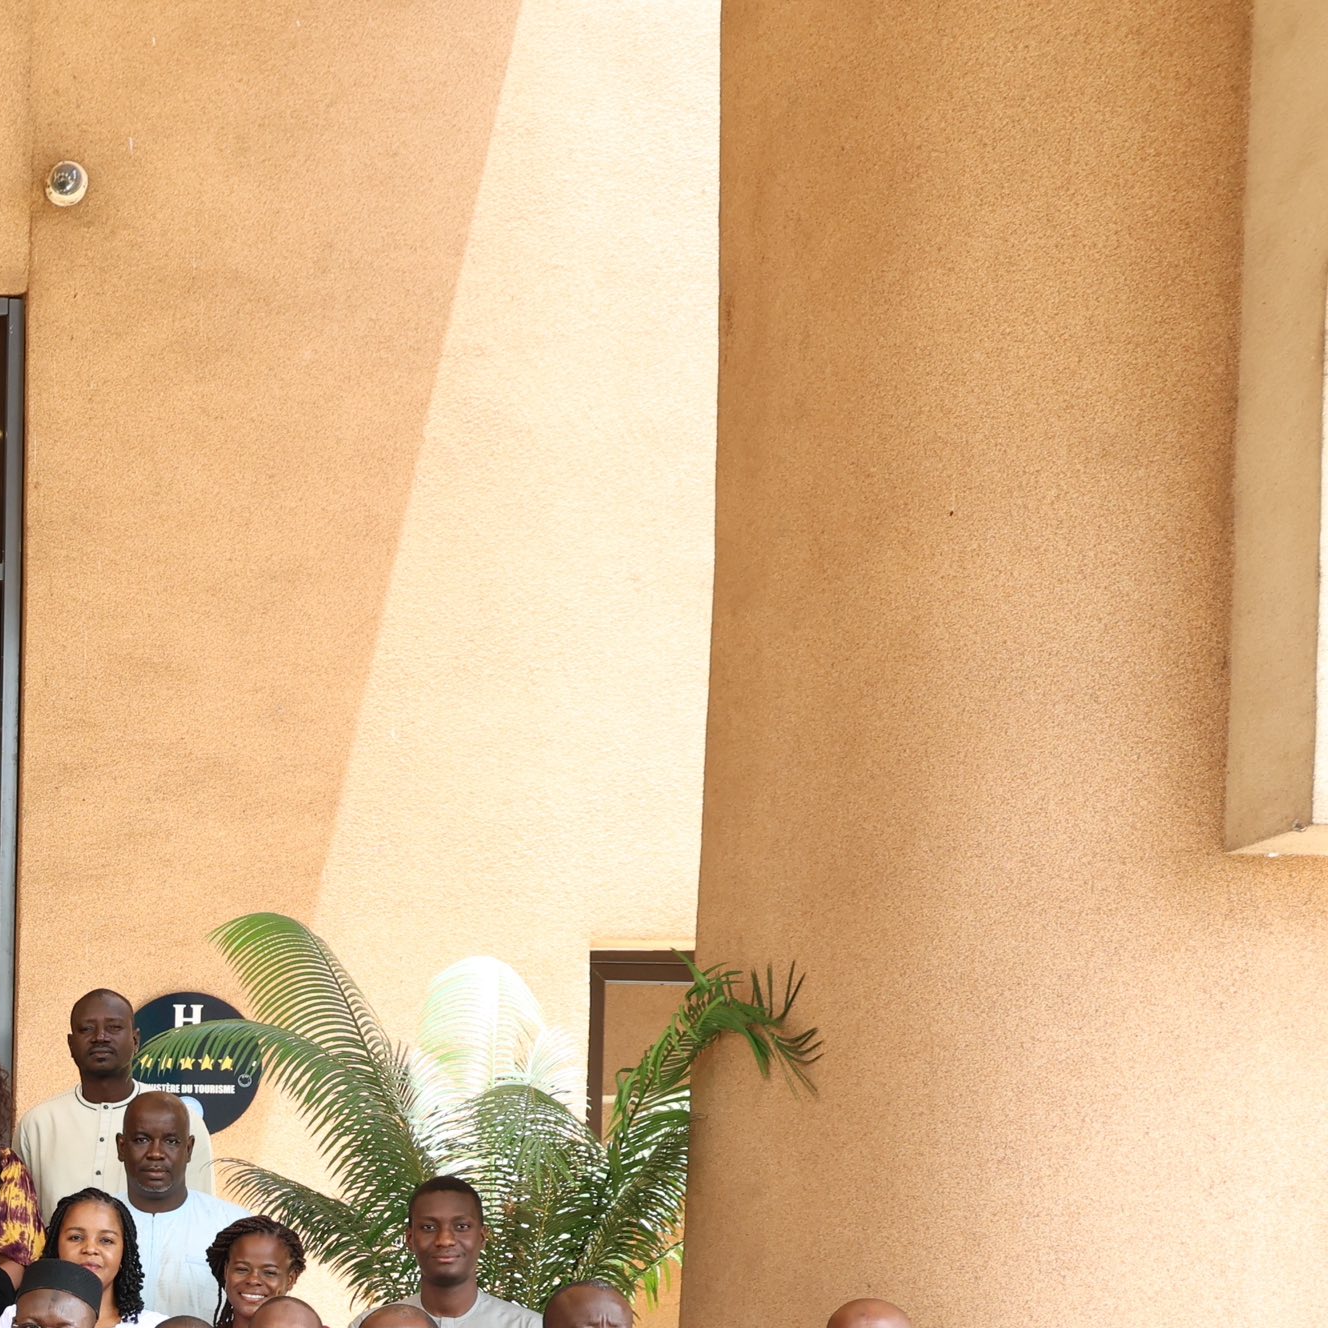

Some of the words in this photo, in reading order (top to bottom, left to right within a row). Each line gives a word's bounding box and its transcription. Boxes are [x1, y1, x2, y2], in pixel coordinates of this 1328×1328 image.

[173, 1004, 204, 1028] H
[181, 1083, 193, 1094] DU
[194, 1084, 235, 1094] TOURISME
